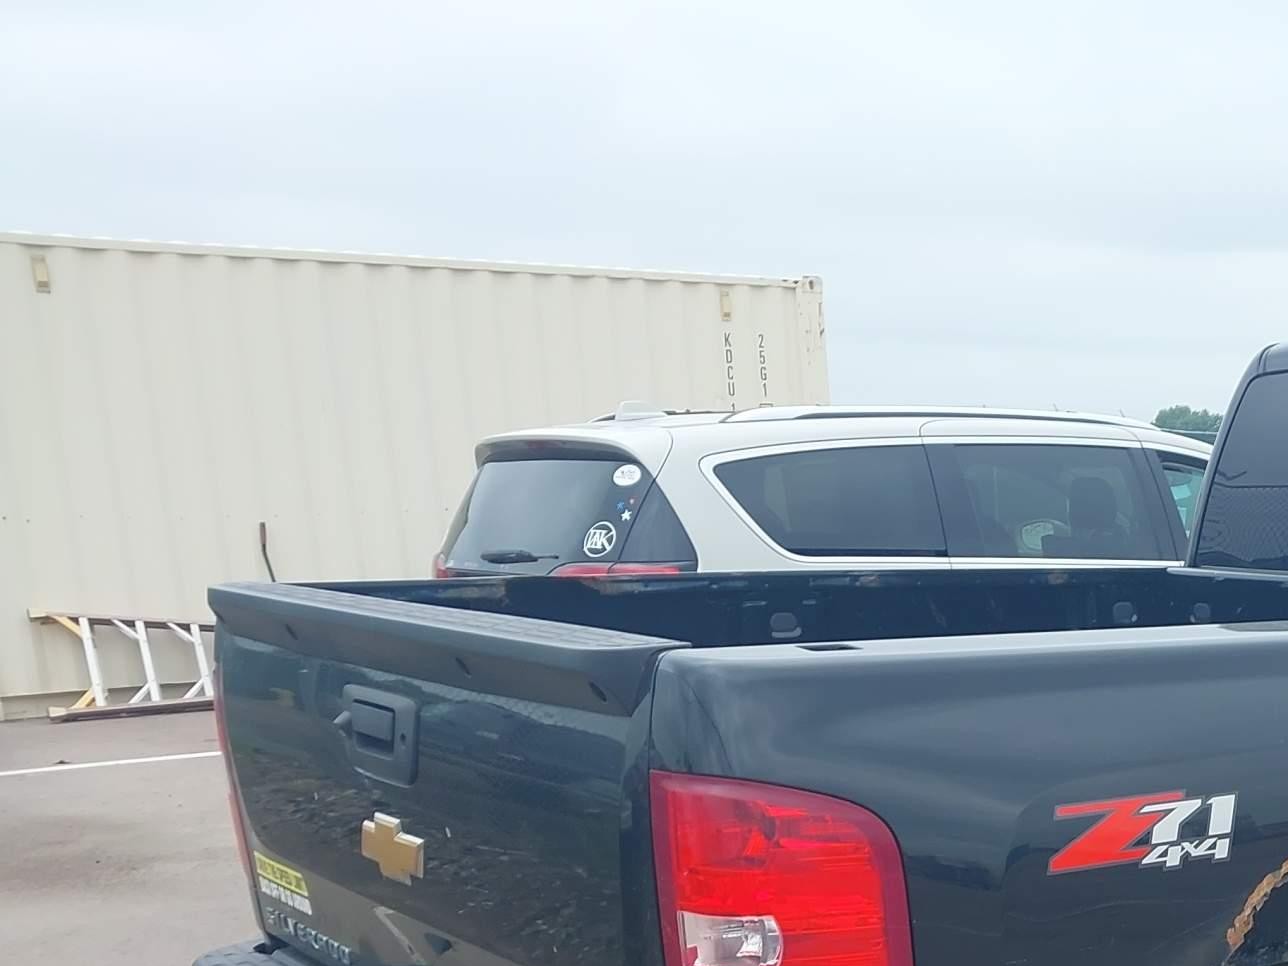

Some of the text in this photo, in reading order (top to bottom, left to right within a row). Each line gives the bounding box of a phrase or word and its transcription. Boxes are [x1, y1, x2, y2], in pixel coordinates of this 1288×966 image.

[724, 331, 735, 397] KDCU
[758, 333, 768, 398] 25G1
[1047, 789, 1238, 875] Z71
